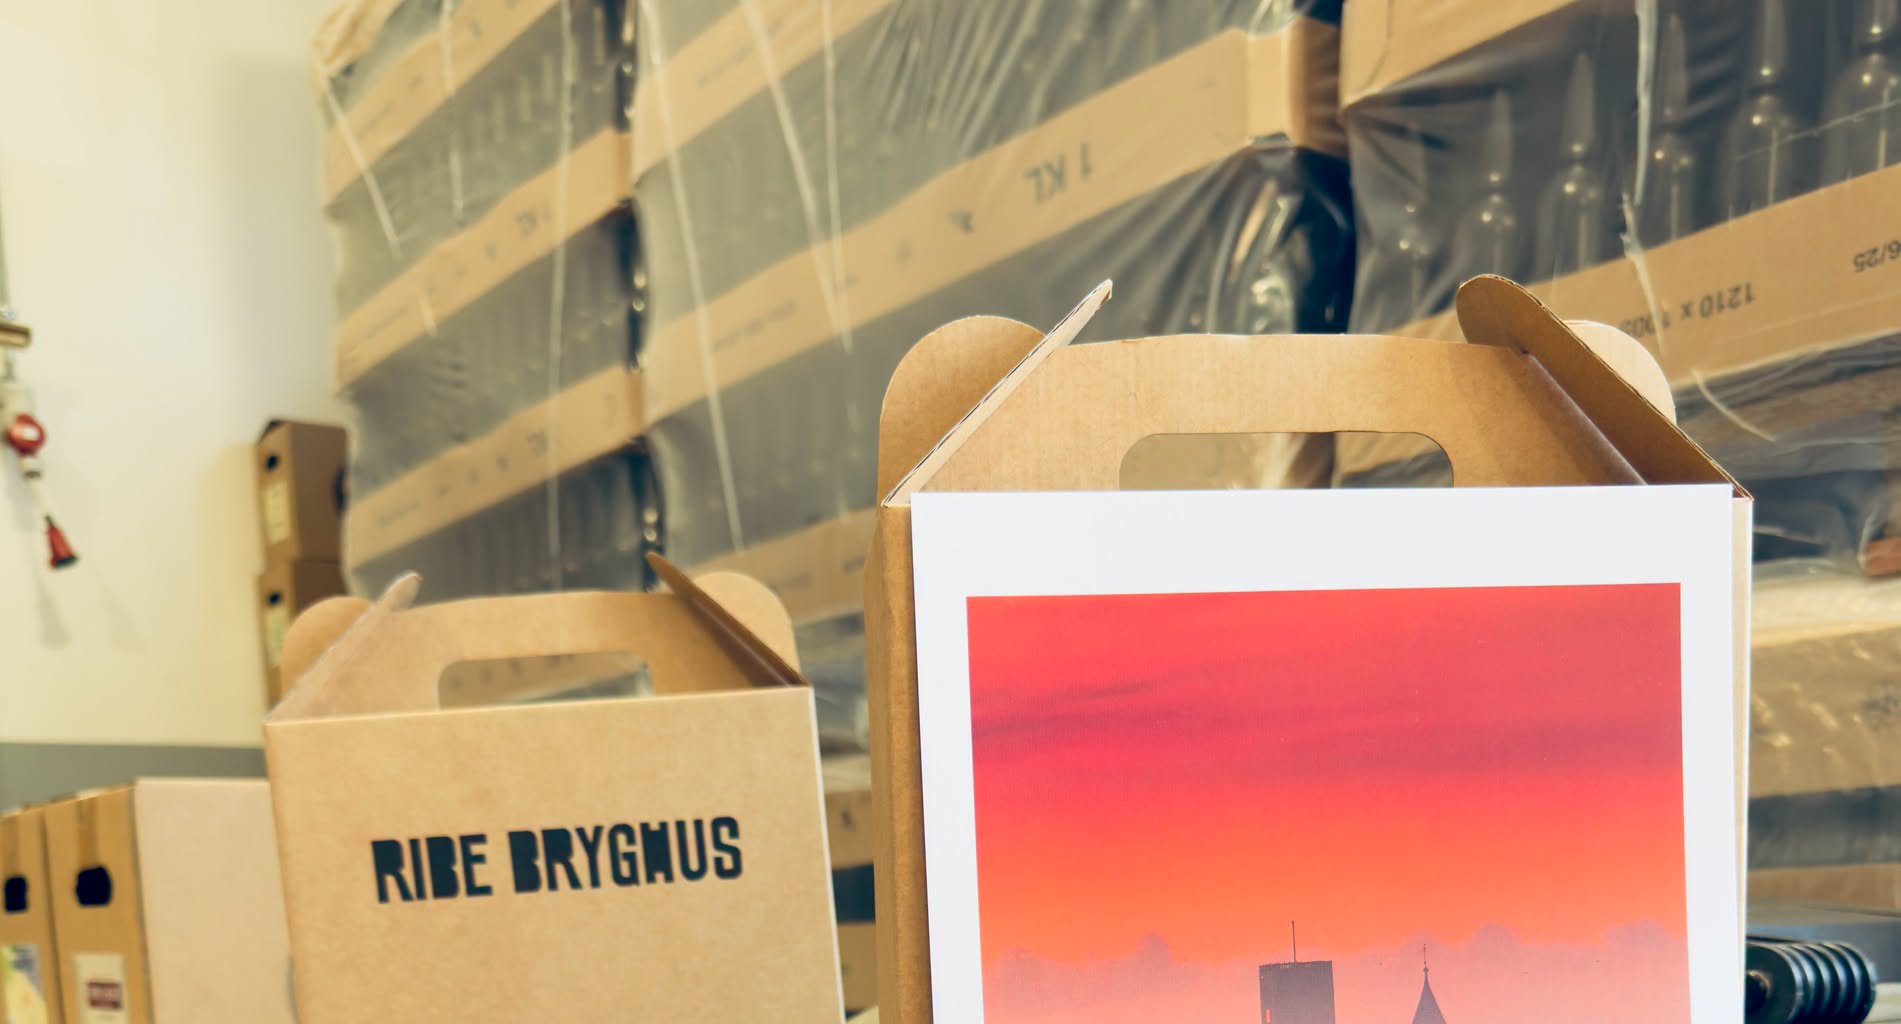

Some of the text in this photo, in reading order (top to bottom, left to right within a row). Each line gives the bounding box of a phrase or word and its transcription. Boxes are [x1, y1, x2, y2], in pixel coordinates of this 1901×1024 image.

[1679, 302, 1698, 320] x
[1700, 281, 1755, 318] 1210
[371, 816, 742, 903] RIBE BRYGHUS
